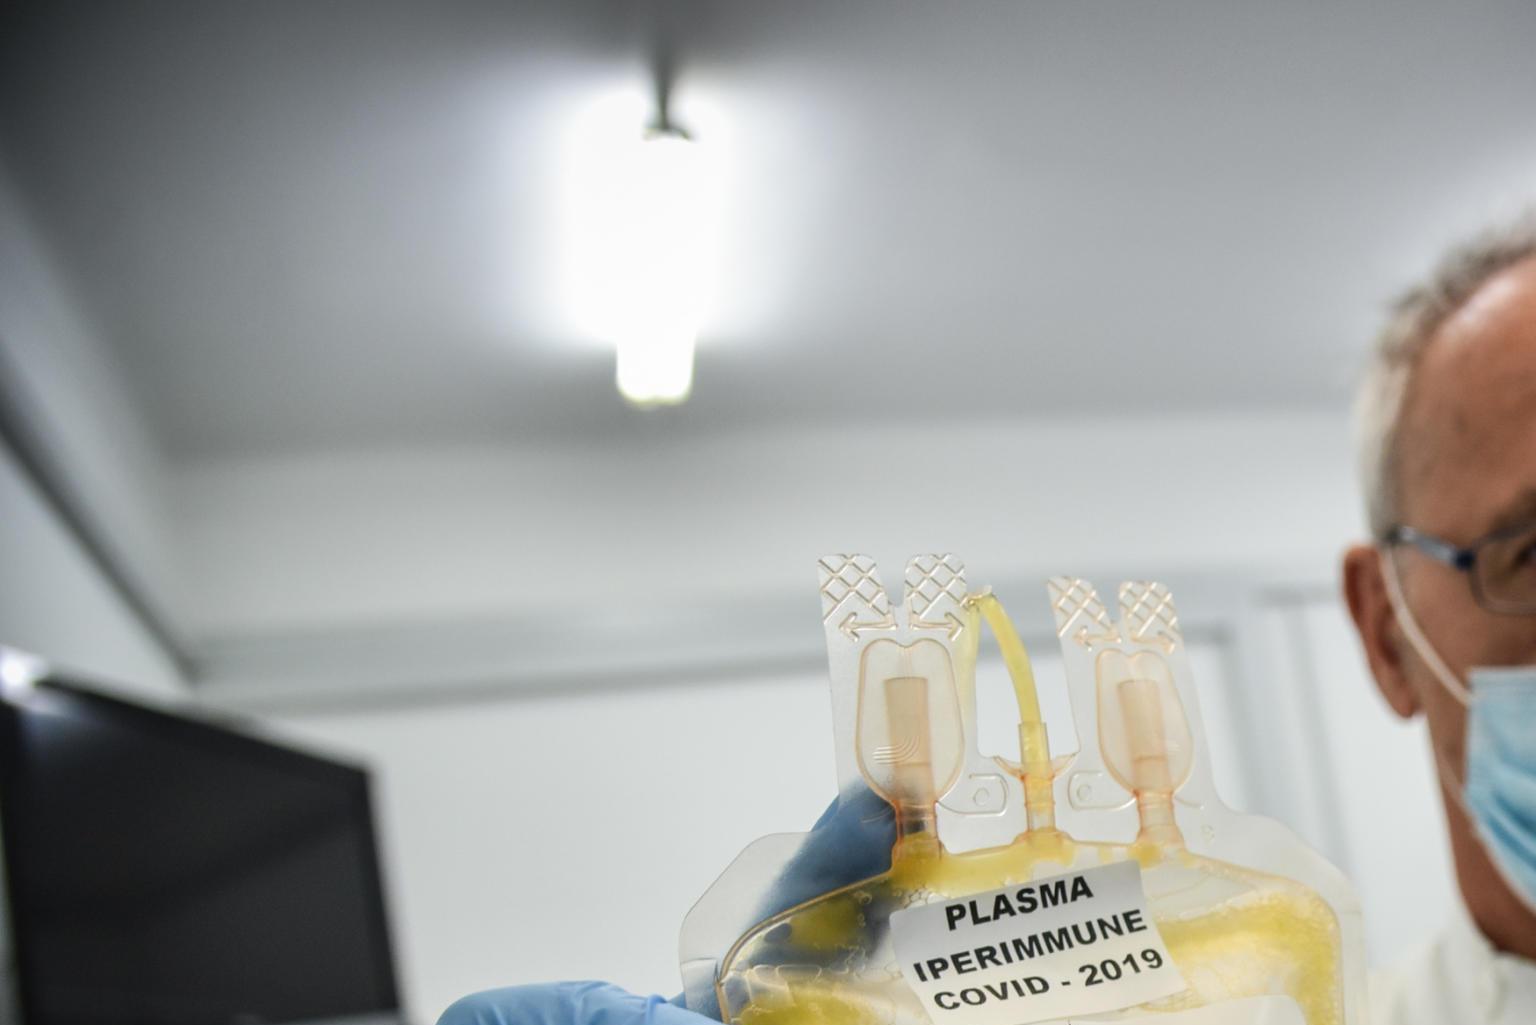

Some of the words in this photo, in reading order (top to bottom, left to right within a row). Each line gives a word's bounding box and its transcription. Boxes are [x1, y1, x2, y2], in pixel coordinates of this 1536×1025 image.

[945, 875, 1094, 931] PLASMA
[913, 909, 1148, 982] IPERIMMUNE
[933, 976, 1050, 1010] COVID
[1078, 949, 1163, 987] 2019
